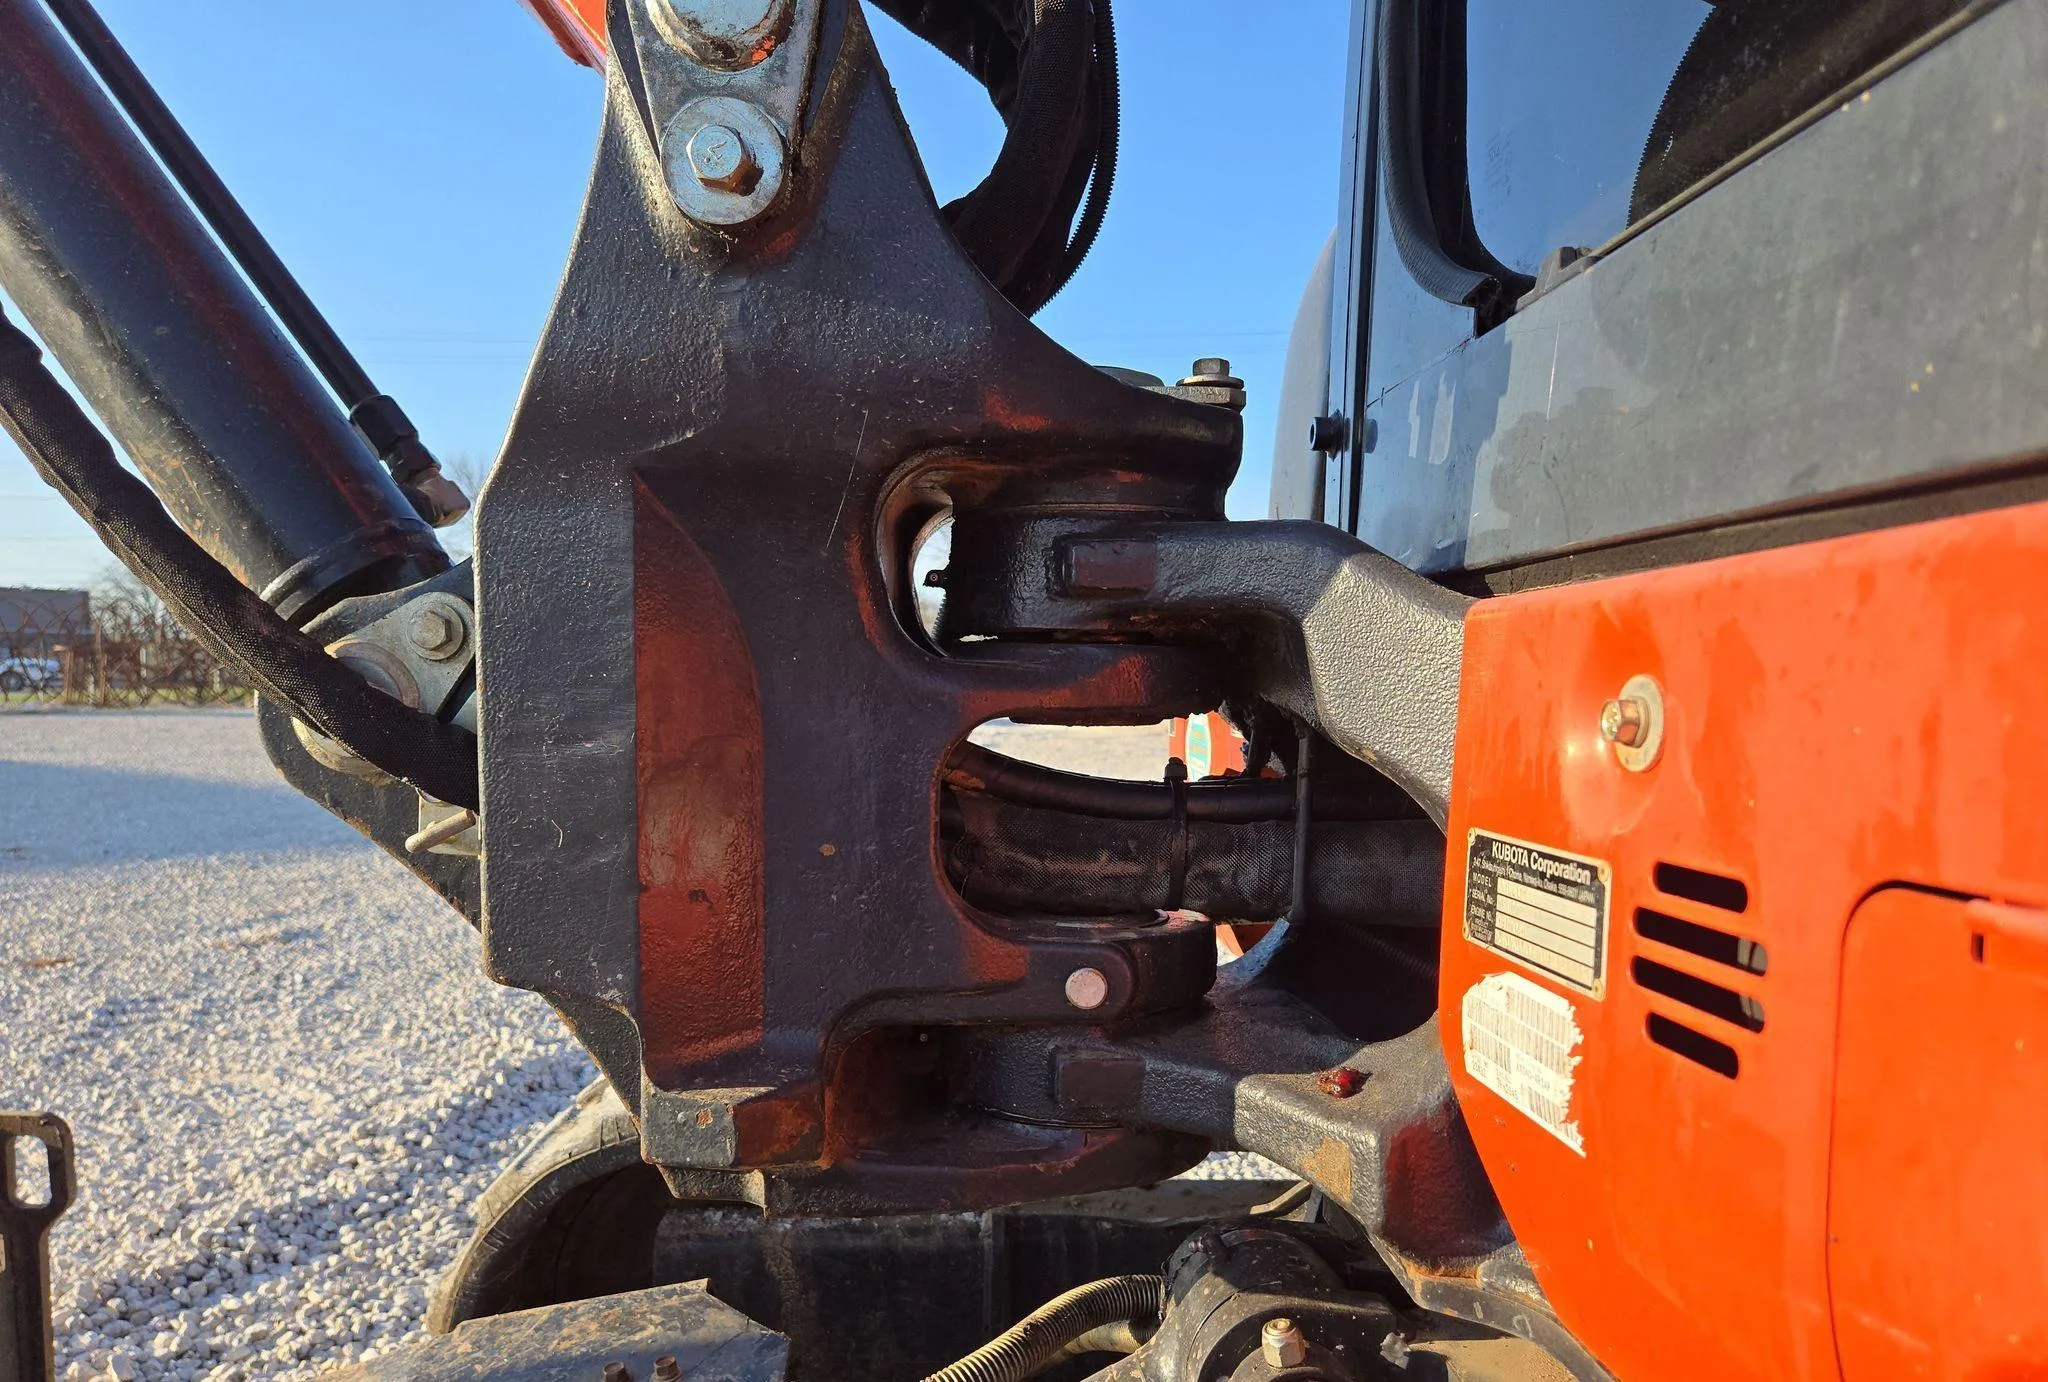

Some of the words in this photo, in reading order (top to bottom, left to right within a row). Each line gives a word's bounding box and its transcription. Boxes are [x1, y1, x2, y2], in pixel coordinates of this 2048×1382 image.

[1492, 841, 1529, 868] KUBOTA
[1530, 852, 1591, 885] Corporation
[1473, 872, 1491, 887] MODEL
[1472, 889, 1485, 902] SERIAL
